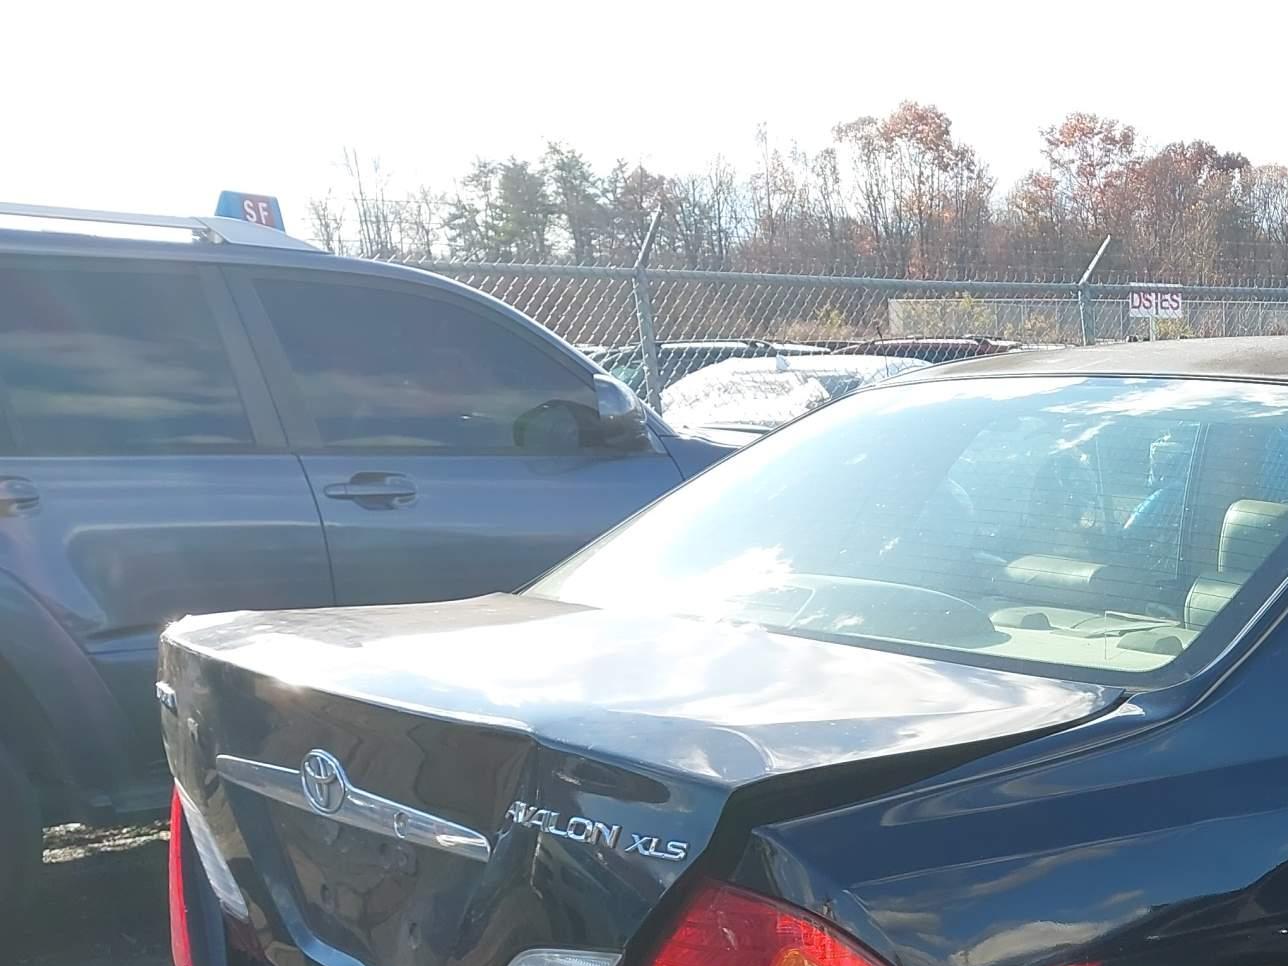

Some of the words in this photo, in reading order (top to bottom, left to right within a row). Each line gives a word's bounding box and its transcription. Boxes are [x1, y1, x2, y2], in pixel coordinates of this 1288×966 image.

[243, 199, 269, 225] SF
[504, 800, 622, 848] AVALON
[624, 833, 689, 861] XLS
